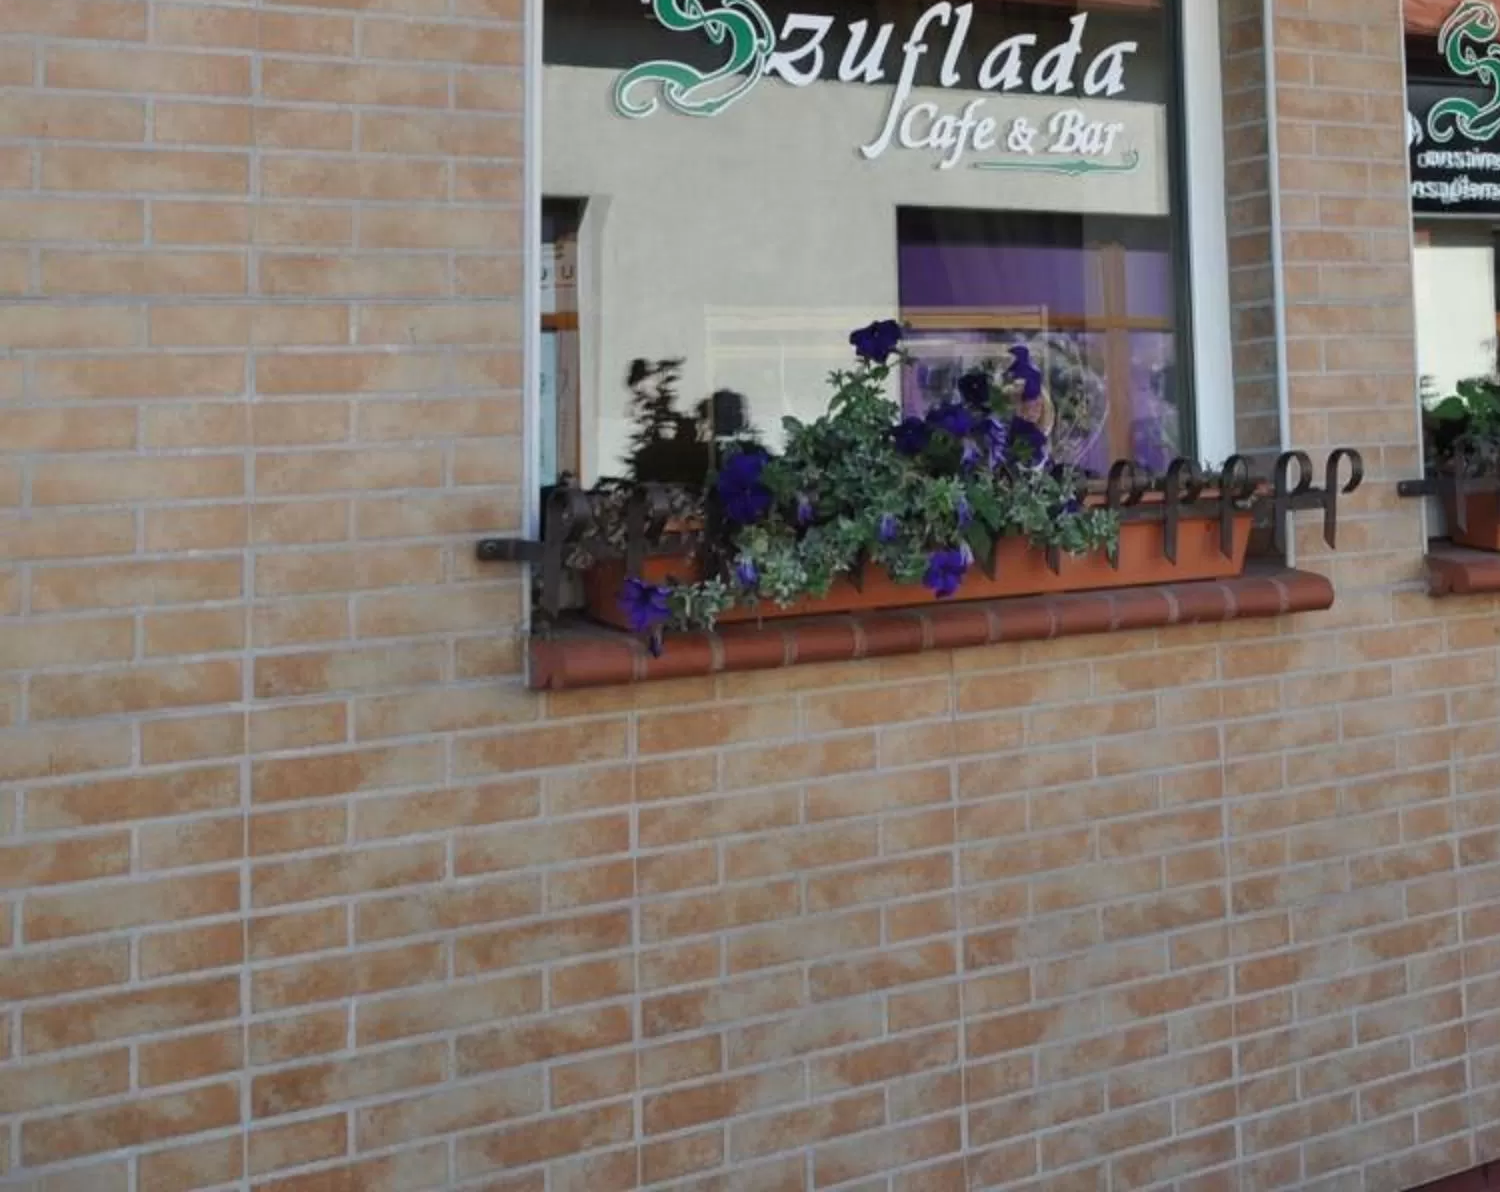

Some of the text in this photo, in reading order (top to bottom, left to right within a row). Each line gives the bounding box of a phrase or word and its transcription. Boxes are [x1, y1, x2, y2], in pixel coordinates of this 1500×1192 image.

[901, 101, 1124, 171] Cafe & Bar
